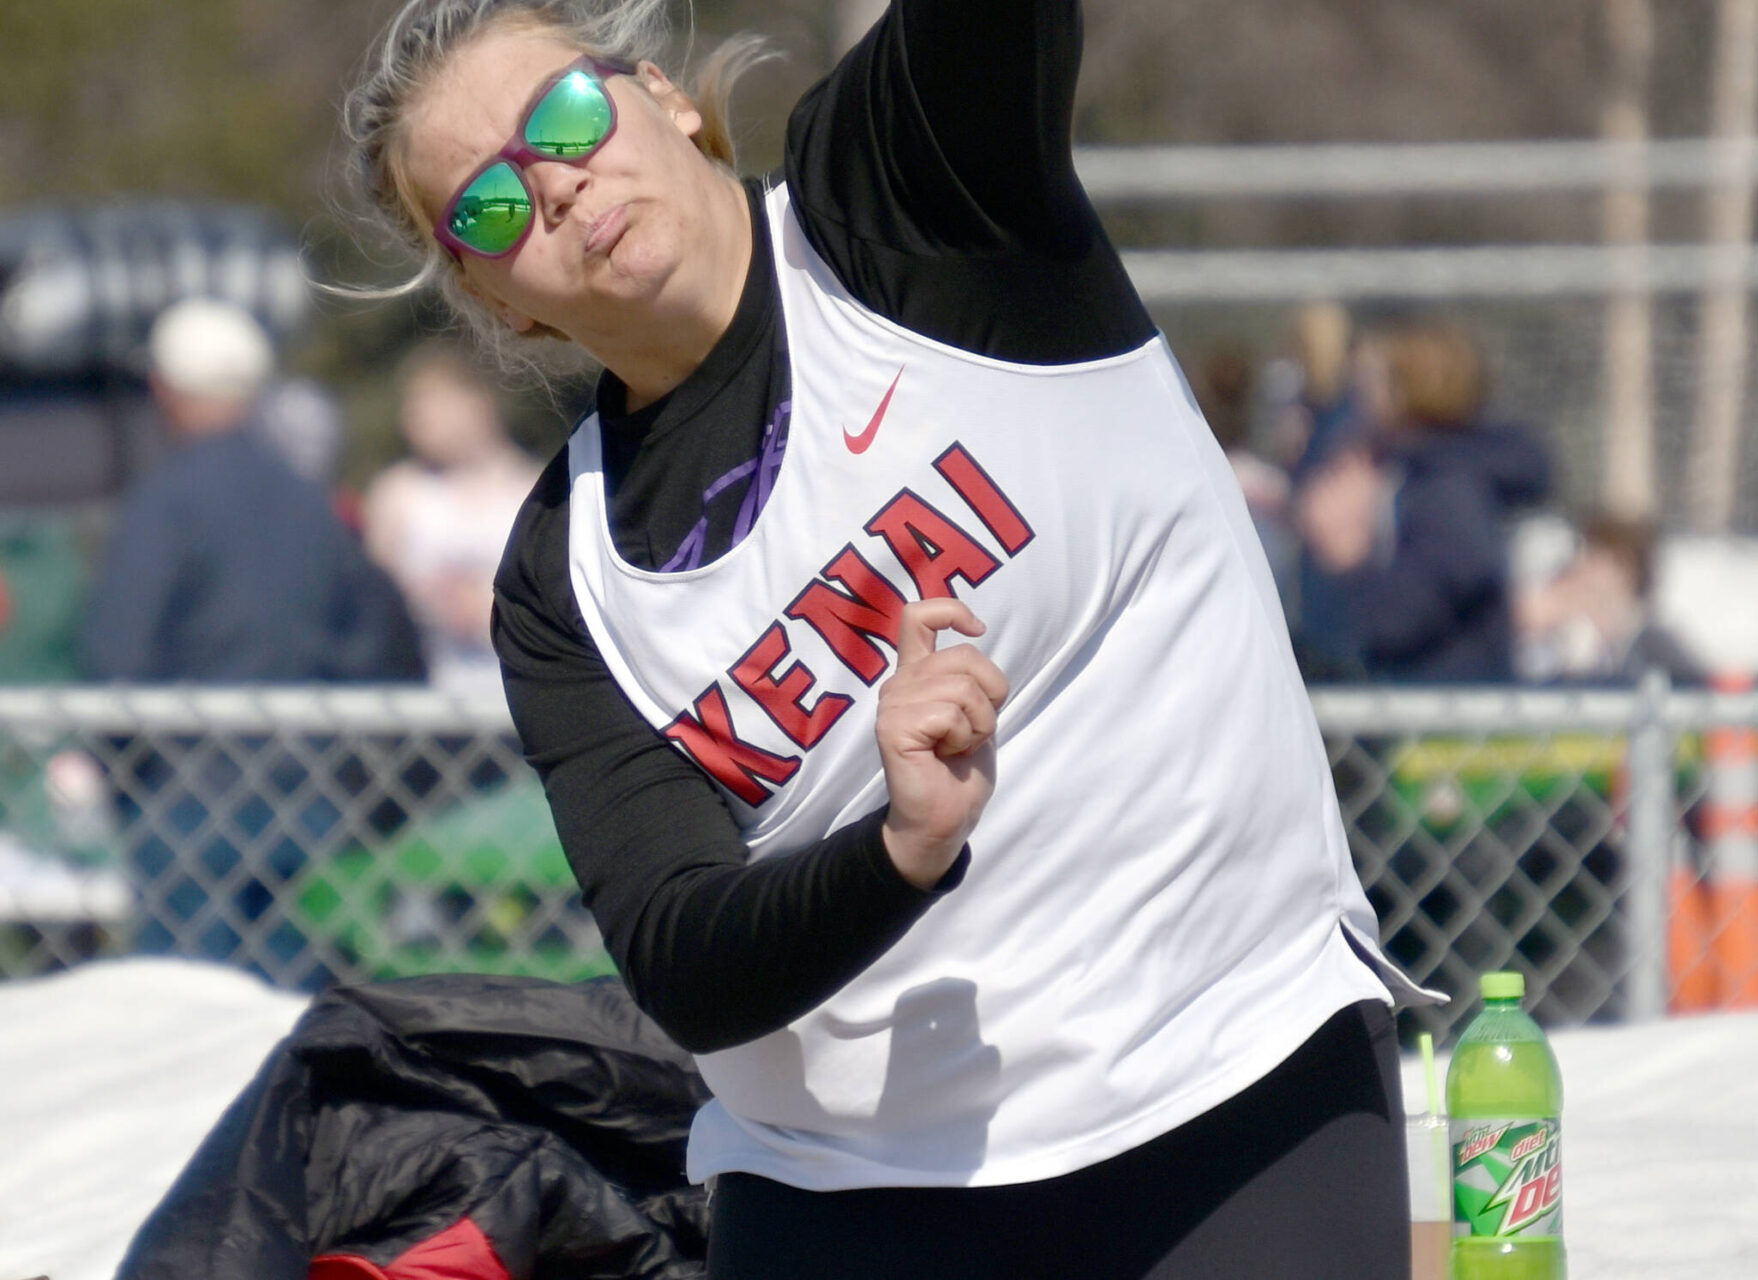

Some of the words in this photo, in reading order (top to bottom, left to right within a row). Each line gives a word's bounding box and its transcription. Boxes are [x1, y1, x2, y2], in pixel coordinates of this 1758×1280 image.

[660, 440, 1036, 808] KENAI
[1507, 1134, 1560, 1193] Mt
[1512, 1128, 1546, 1160] diet
[1509, 1161, 1560, 1225] De
